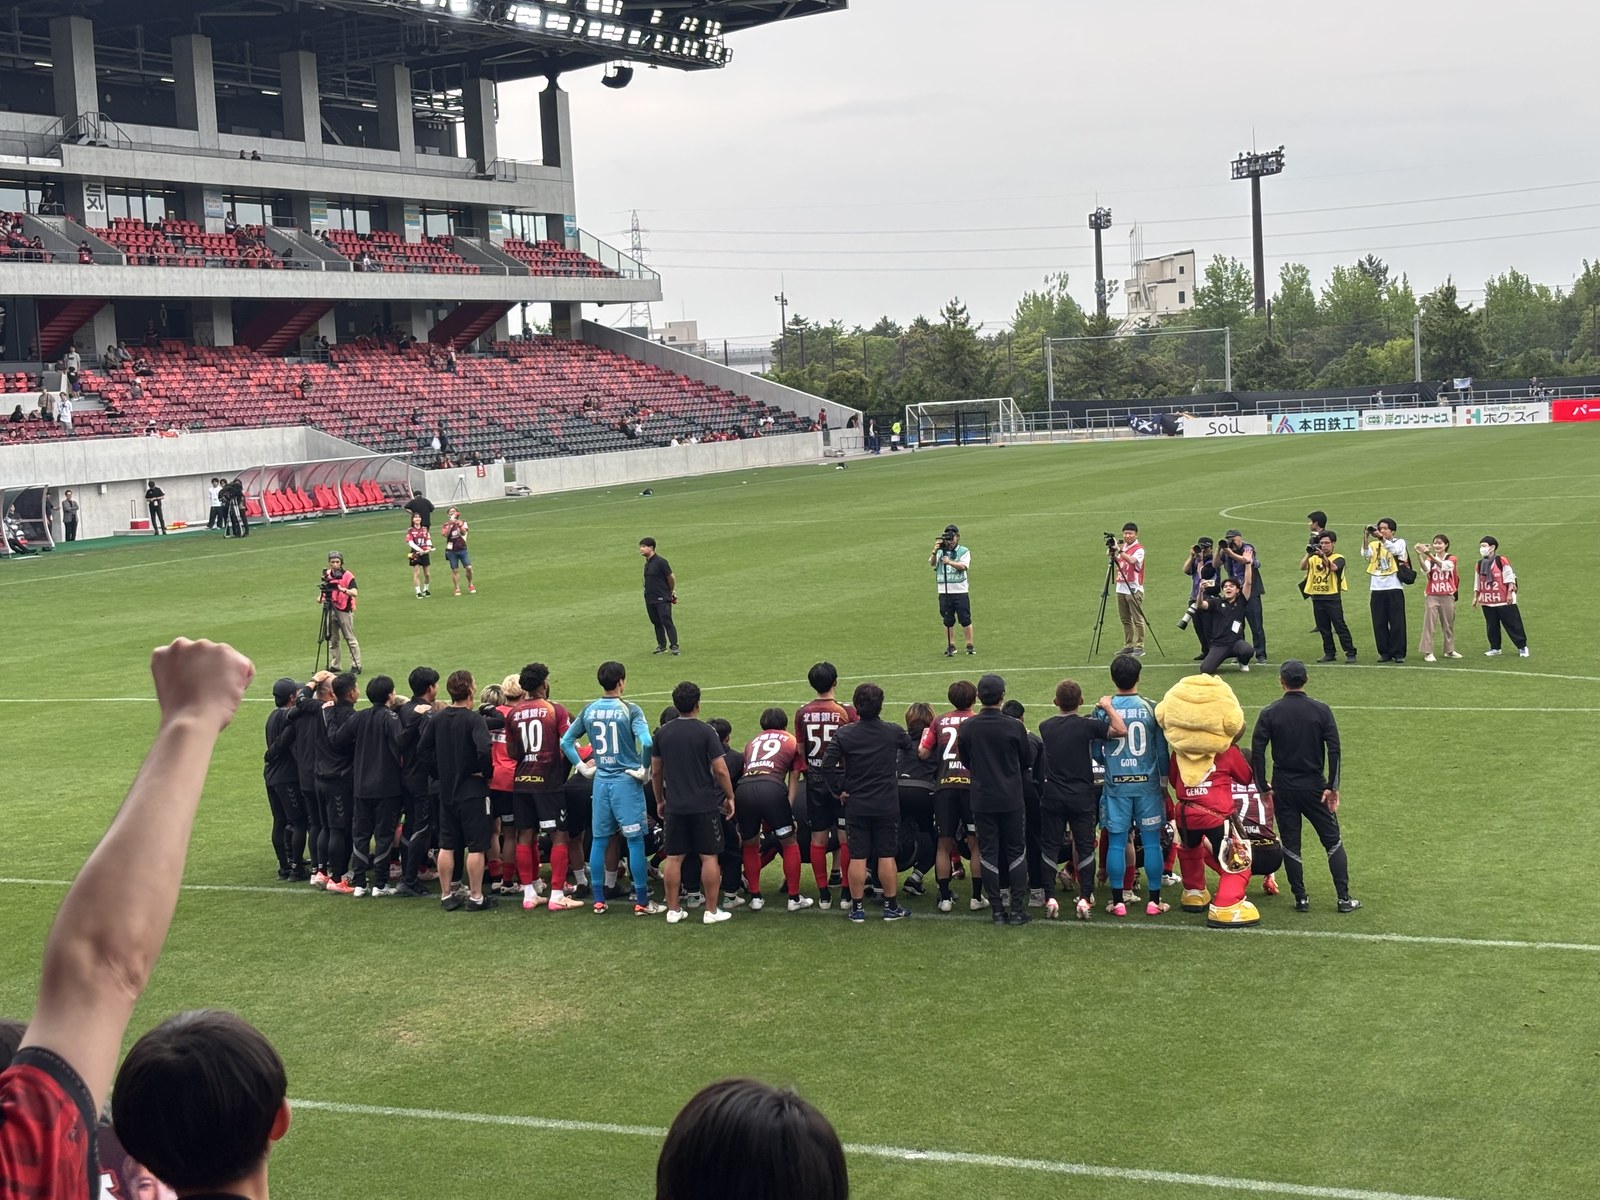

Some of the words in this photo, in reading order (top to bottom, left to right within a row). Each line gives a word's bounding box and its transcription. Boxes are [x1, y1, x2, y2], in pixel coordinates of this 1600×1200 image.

[86, 183, 104, 212] 気
[1205, 417, 1245, 436] soil
[1299, 416, 1356, 432] 本田鉄工
[1384, 413, 1449, 426] 岸グリーンサービス
[517, 719, 543, 753] 10
[593, 721, 619, 755] 31
[750, 739, 782, 762] 19
[1120, 758, 1138, 767] GOTO
[1185, 787, 1209, 797] GENZO
[1231, 793, 1266, 826] 71
[1243, 825, 1261, 834] FUGA
